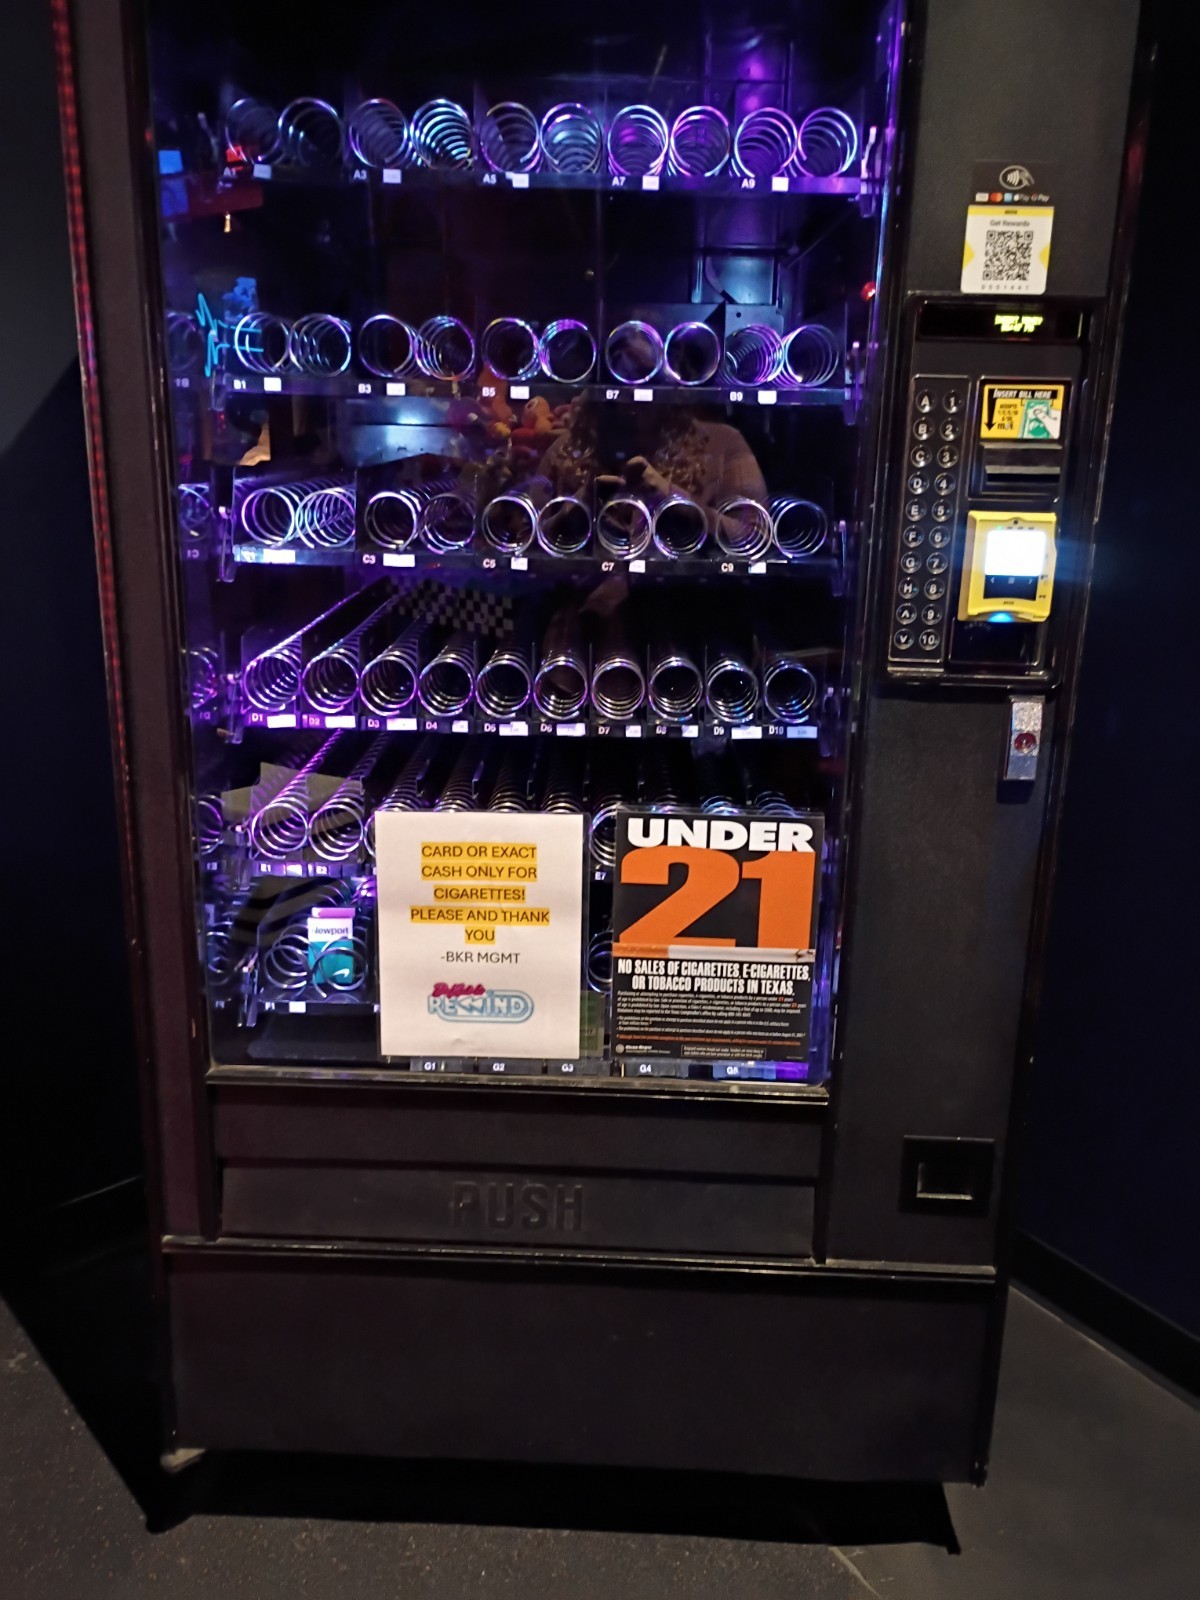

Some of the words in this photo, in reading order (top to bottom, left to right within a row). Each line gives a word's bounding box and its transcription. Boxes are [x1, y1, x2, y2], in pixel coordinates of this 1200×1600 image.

[353, 169, 367, 181] A3
[483, 173, 497, 185] A5
[612, 176, 626, 187] A7
[741, 177, 755, 189] A9
[233, 379, 247, 390] B1
[358, 383, 371, 394] B3
[482, 386, 496, 397] B5
[606, 389, 619, 400] B7
[729, 391, 743, 402] B9
[921, 395, 930, 406] A
[949, 396, 955, 406] 1
[918, 423, 927, 434] B
[945, 424, 953, 435] 2
[915, 451, 925, 461] C
[942, 451, 950, 462] 3
[913, 478, 922, 488] D
[940, 479, 947, 488] 4
[911, 505, 919, 515] E
[937, 505, 944, 515] 5
[908, 531, 917, 541] F
[934, 531, 942, 541] 6
[362, 554, 376, 564] C3
[483, 558, 496, 569] C5
[906, 557, 915, 568] G
[932, 558, 939, 568] 7
[601, 562, 615, 572] C7
[721, 562, 734, 573] C9
[903, 583, 912, 594] H
[929, 583, 937, 594] 8
[927, 609, 934, 620] 9
[922, 635, 935, 645] 10
[252, 713, 263, 722] D1
[309, 717, 320, 726] D2
[367, 719, 380, 729] D3
[425, 721, 438, 731] D4
[484, 723, 496, 733] D5
[540, 723, 553, 733] D6
[598, 725, 611, 735] D7
[713, 726, 725, 736] D9
[768, 725, 784, 736] D10
[627, 817, 814, 853] UNDER
[421, 845, 463, 858] CARD
[466, 845, 488, 858] OR
[491, 846, 537, 859] EXACT
[421, 865, 462, 878] CASH
[465, 866, 505, 879] ONLY
[508, 867, 537, 879] FOR
[433, 887, 526, 900] CIGARETTES!
[619, 845, 816, 949] 21
[410, 908, 463, 921] PLEASE
[467, 909, 498, 922] AND
[502, 910, 550, 923] THANK
[465, 929, 495, 942] YOU
[440, 951, 474, 963] -BKR
[477, 951, 520, 964] MGMT
[617, 958, 633, 974] NO
[634, 959, 665, 975] SALES
[667, 960, 680, 976] OF
[681, 961, 741, 979] CIGARETTES,
[742, 963, 811, 981] E-CIGARETTES,
[632, 975, 646, 990] OR
[648, 975, 692, 991] TOBACCO
[693, 976, 745, 993] PRODUCTS
[746, 979, 758, 994] IN
[760, 980, 795, 996] TEXAS.
[424, 1062, 436, 1071] G1
[492, 1062, 505, 1072] G2
[561, 1063, 574, 1073] G3
[640, 1064, 652, 1073] G4
[453, 1180, 584, 1231] PUSH
